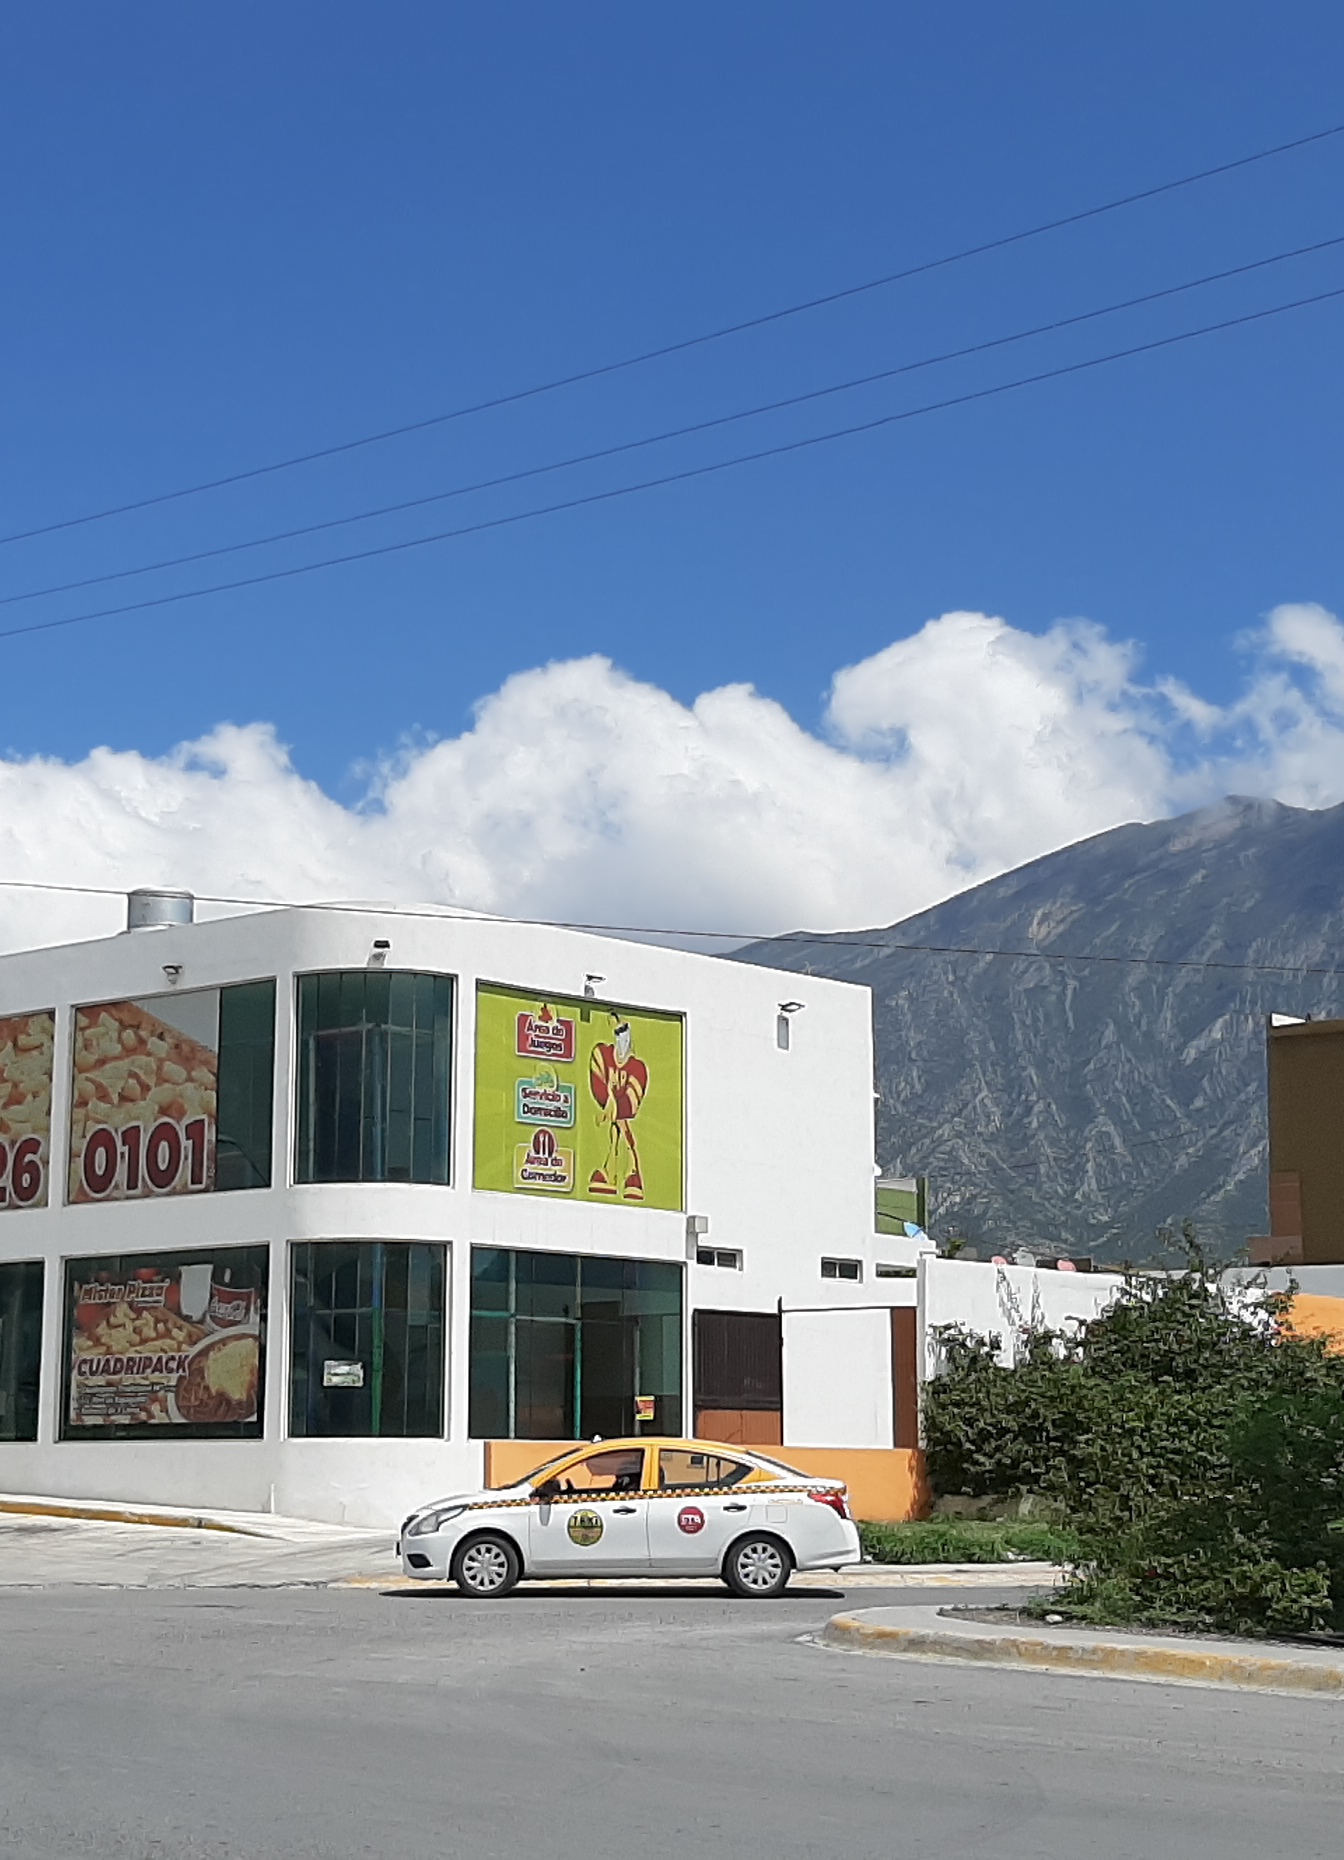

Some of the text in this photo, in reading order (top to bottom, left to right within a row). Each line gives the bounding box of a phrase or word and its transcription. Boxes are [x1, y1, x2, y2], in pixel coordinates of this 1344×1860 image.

[528, 1035, 564, 1054] Juegos
[521, 1087, 561, 1102] Servicio
[82, 1115, 207, 1197] 0101
[520, 1168, 567, 1183] Comedor
[76, 1353, 191, 1378] CUADRIPACK
